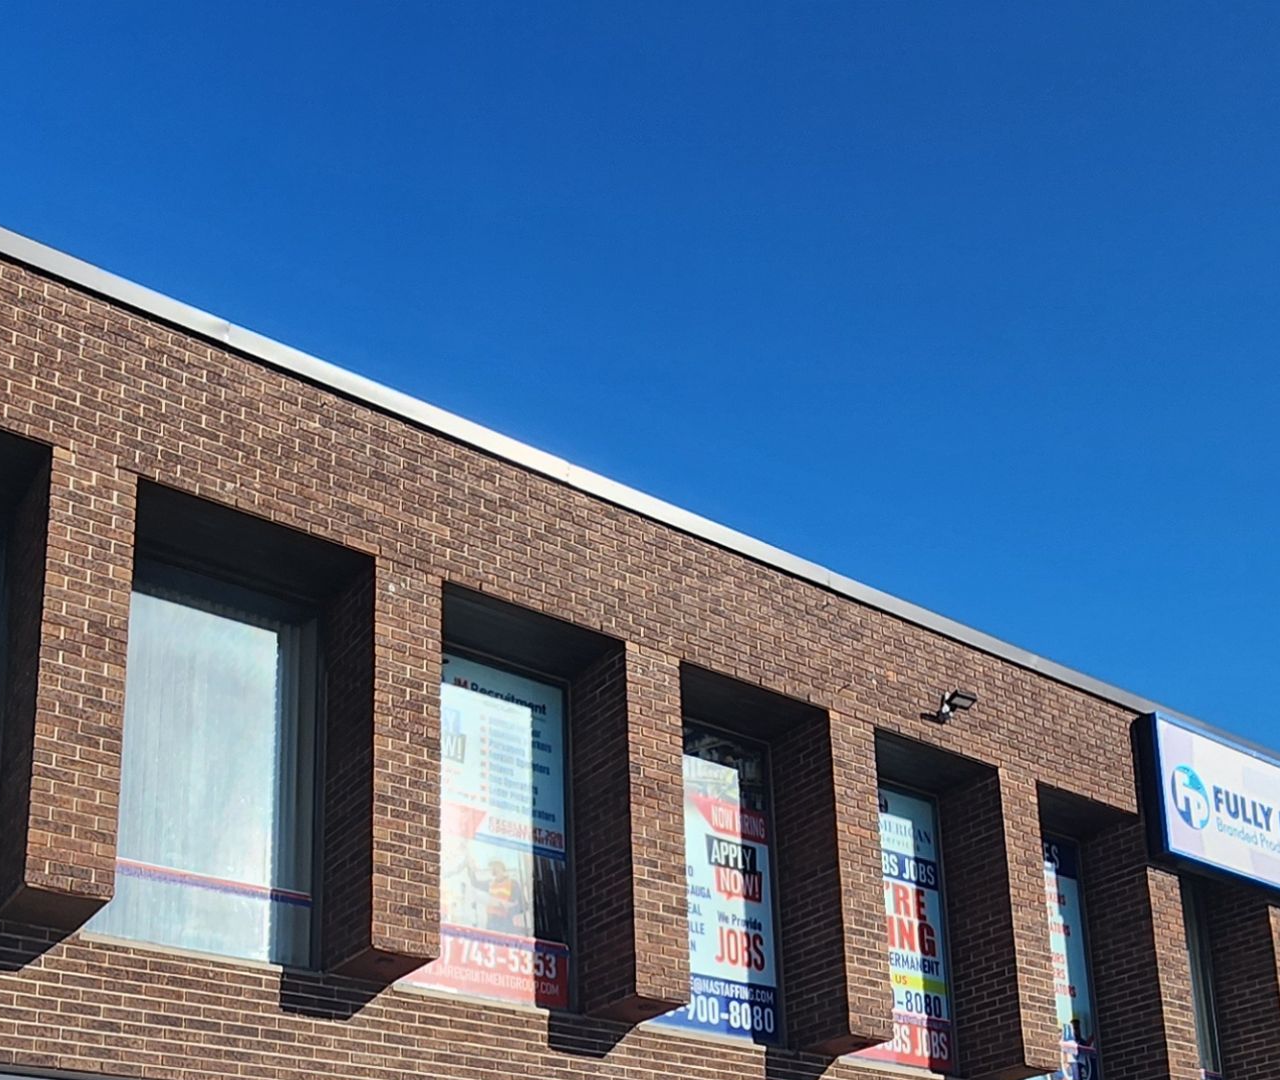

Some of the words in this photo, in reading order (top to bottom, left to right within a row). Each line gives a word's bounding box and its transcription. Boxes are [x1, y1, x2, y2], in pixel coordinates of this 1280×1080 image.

[711, 806, 732, 830] NOW
[1213, 785, 1273, 833] FULLY
[1216, 816, 1258, 845] Branded
[710, 839, 752, 869] APPLY
[718, 870, 760, 899] NOW!
[903, 858, 936, 887] JOBS
[717, 910, 729, 923] We
[732, 913, 762, 932] Provide
[715, 926, 765, 972] JOBS
[891, 988, 943, 1018] -8080
[914, 1026, 948, 1061] JOBS
